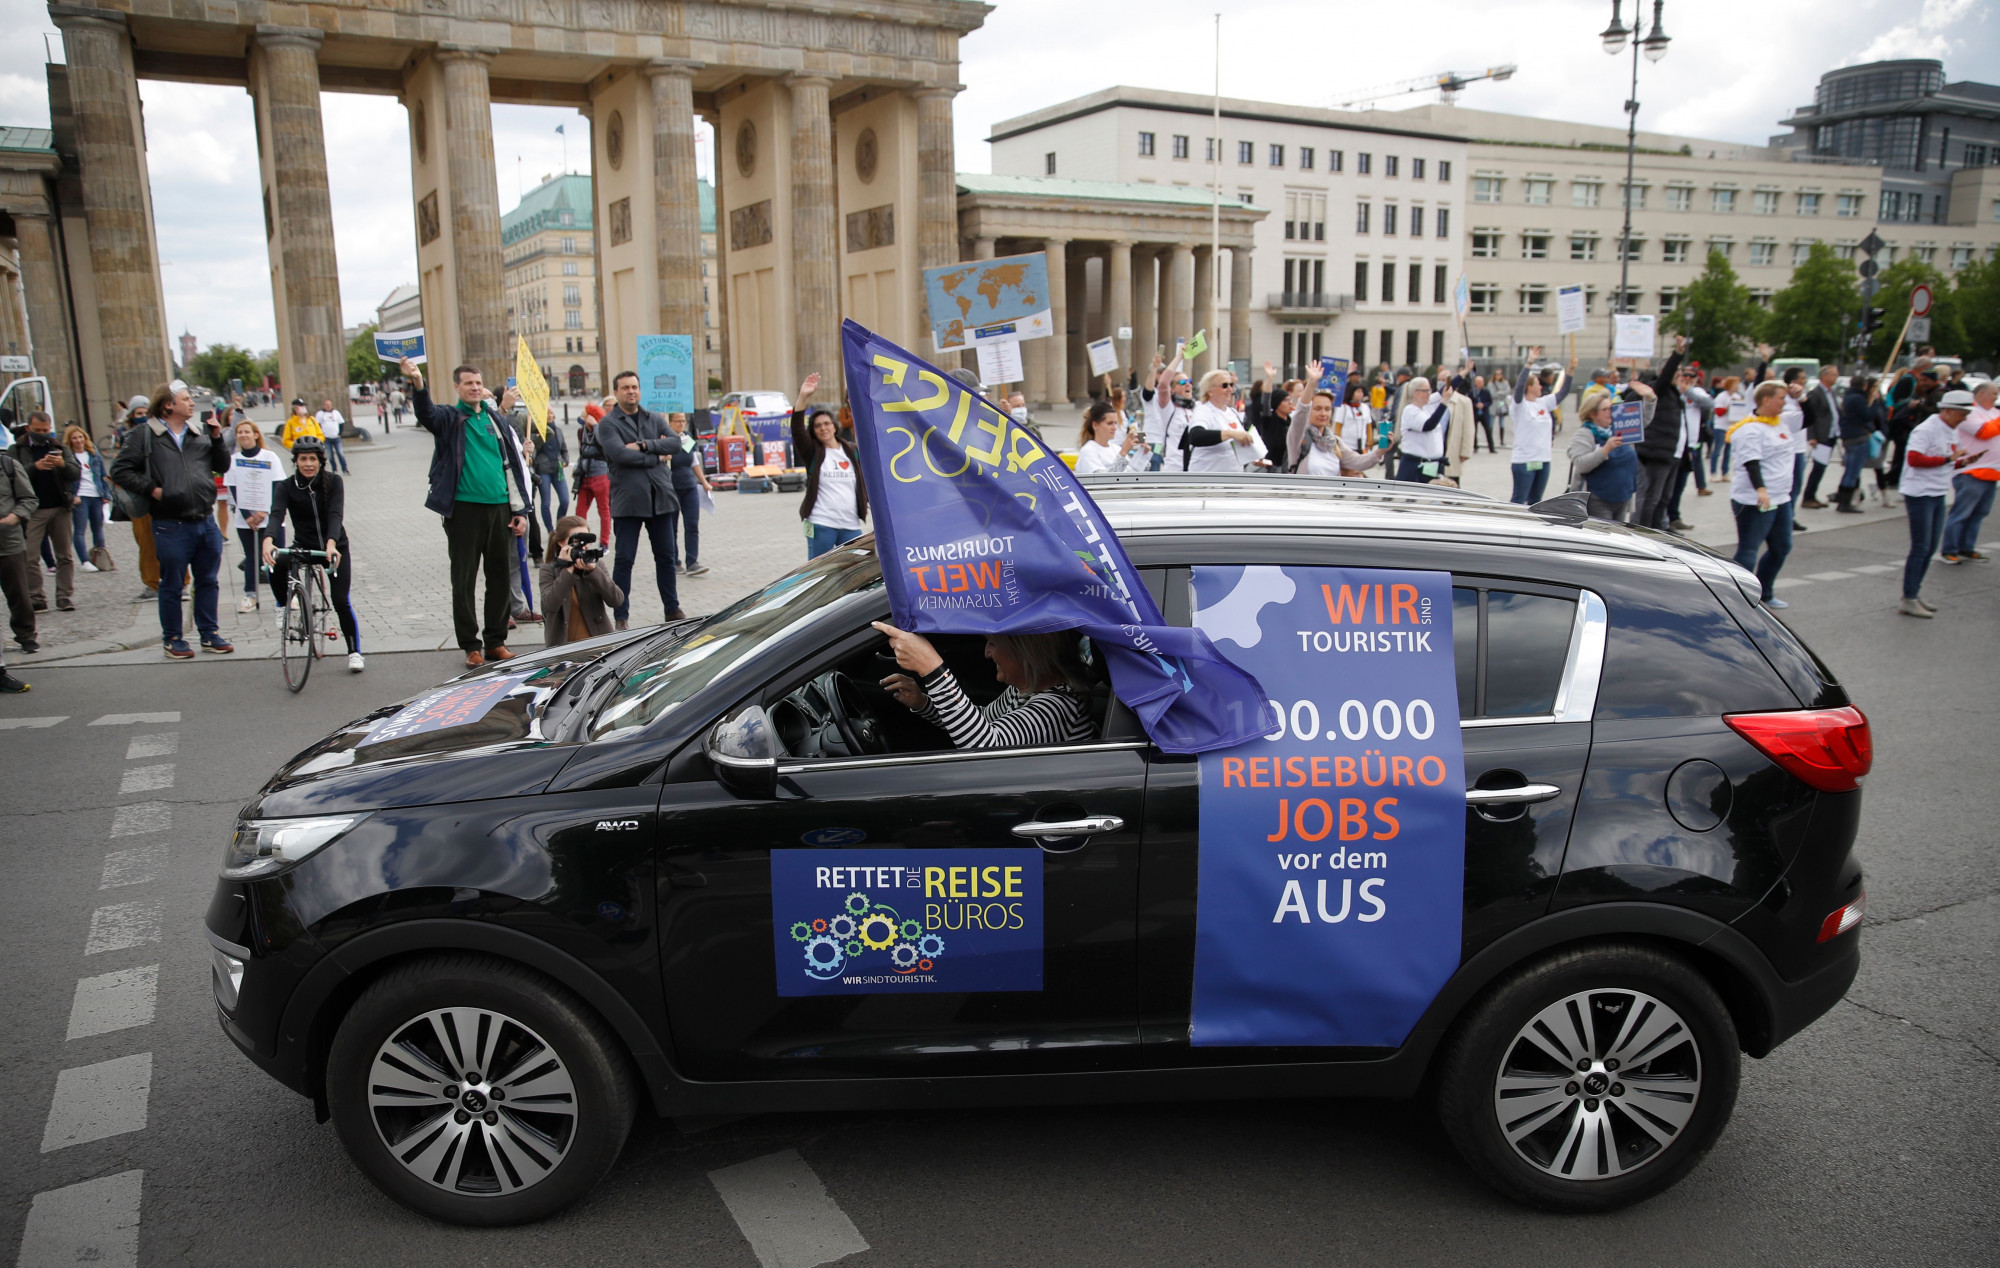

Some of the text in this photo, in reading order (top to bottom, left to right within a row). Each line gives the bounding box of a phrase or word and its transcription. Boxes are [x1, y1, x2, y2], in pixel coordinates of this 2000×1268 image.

[764, 441, 784, 454] SOS
[1321, 584, 1432, 625] WIR SIND
[1296, 630, 1433, 653] TOURISTIK
[1222, 749, 1447, 788] REISEBÜRO
[594, 820, 639, 832] AWD
[1266, 797, 1400, 842] JOBS
[1277, 846, 1388, 870] vor dem
[816, 865, 1024, 898] RETTET DIE REISE
[925, 898, 1025, 931] BÜROS
[1272, 878, 1387, 924] AUS
